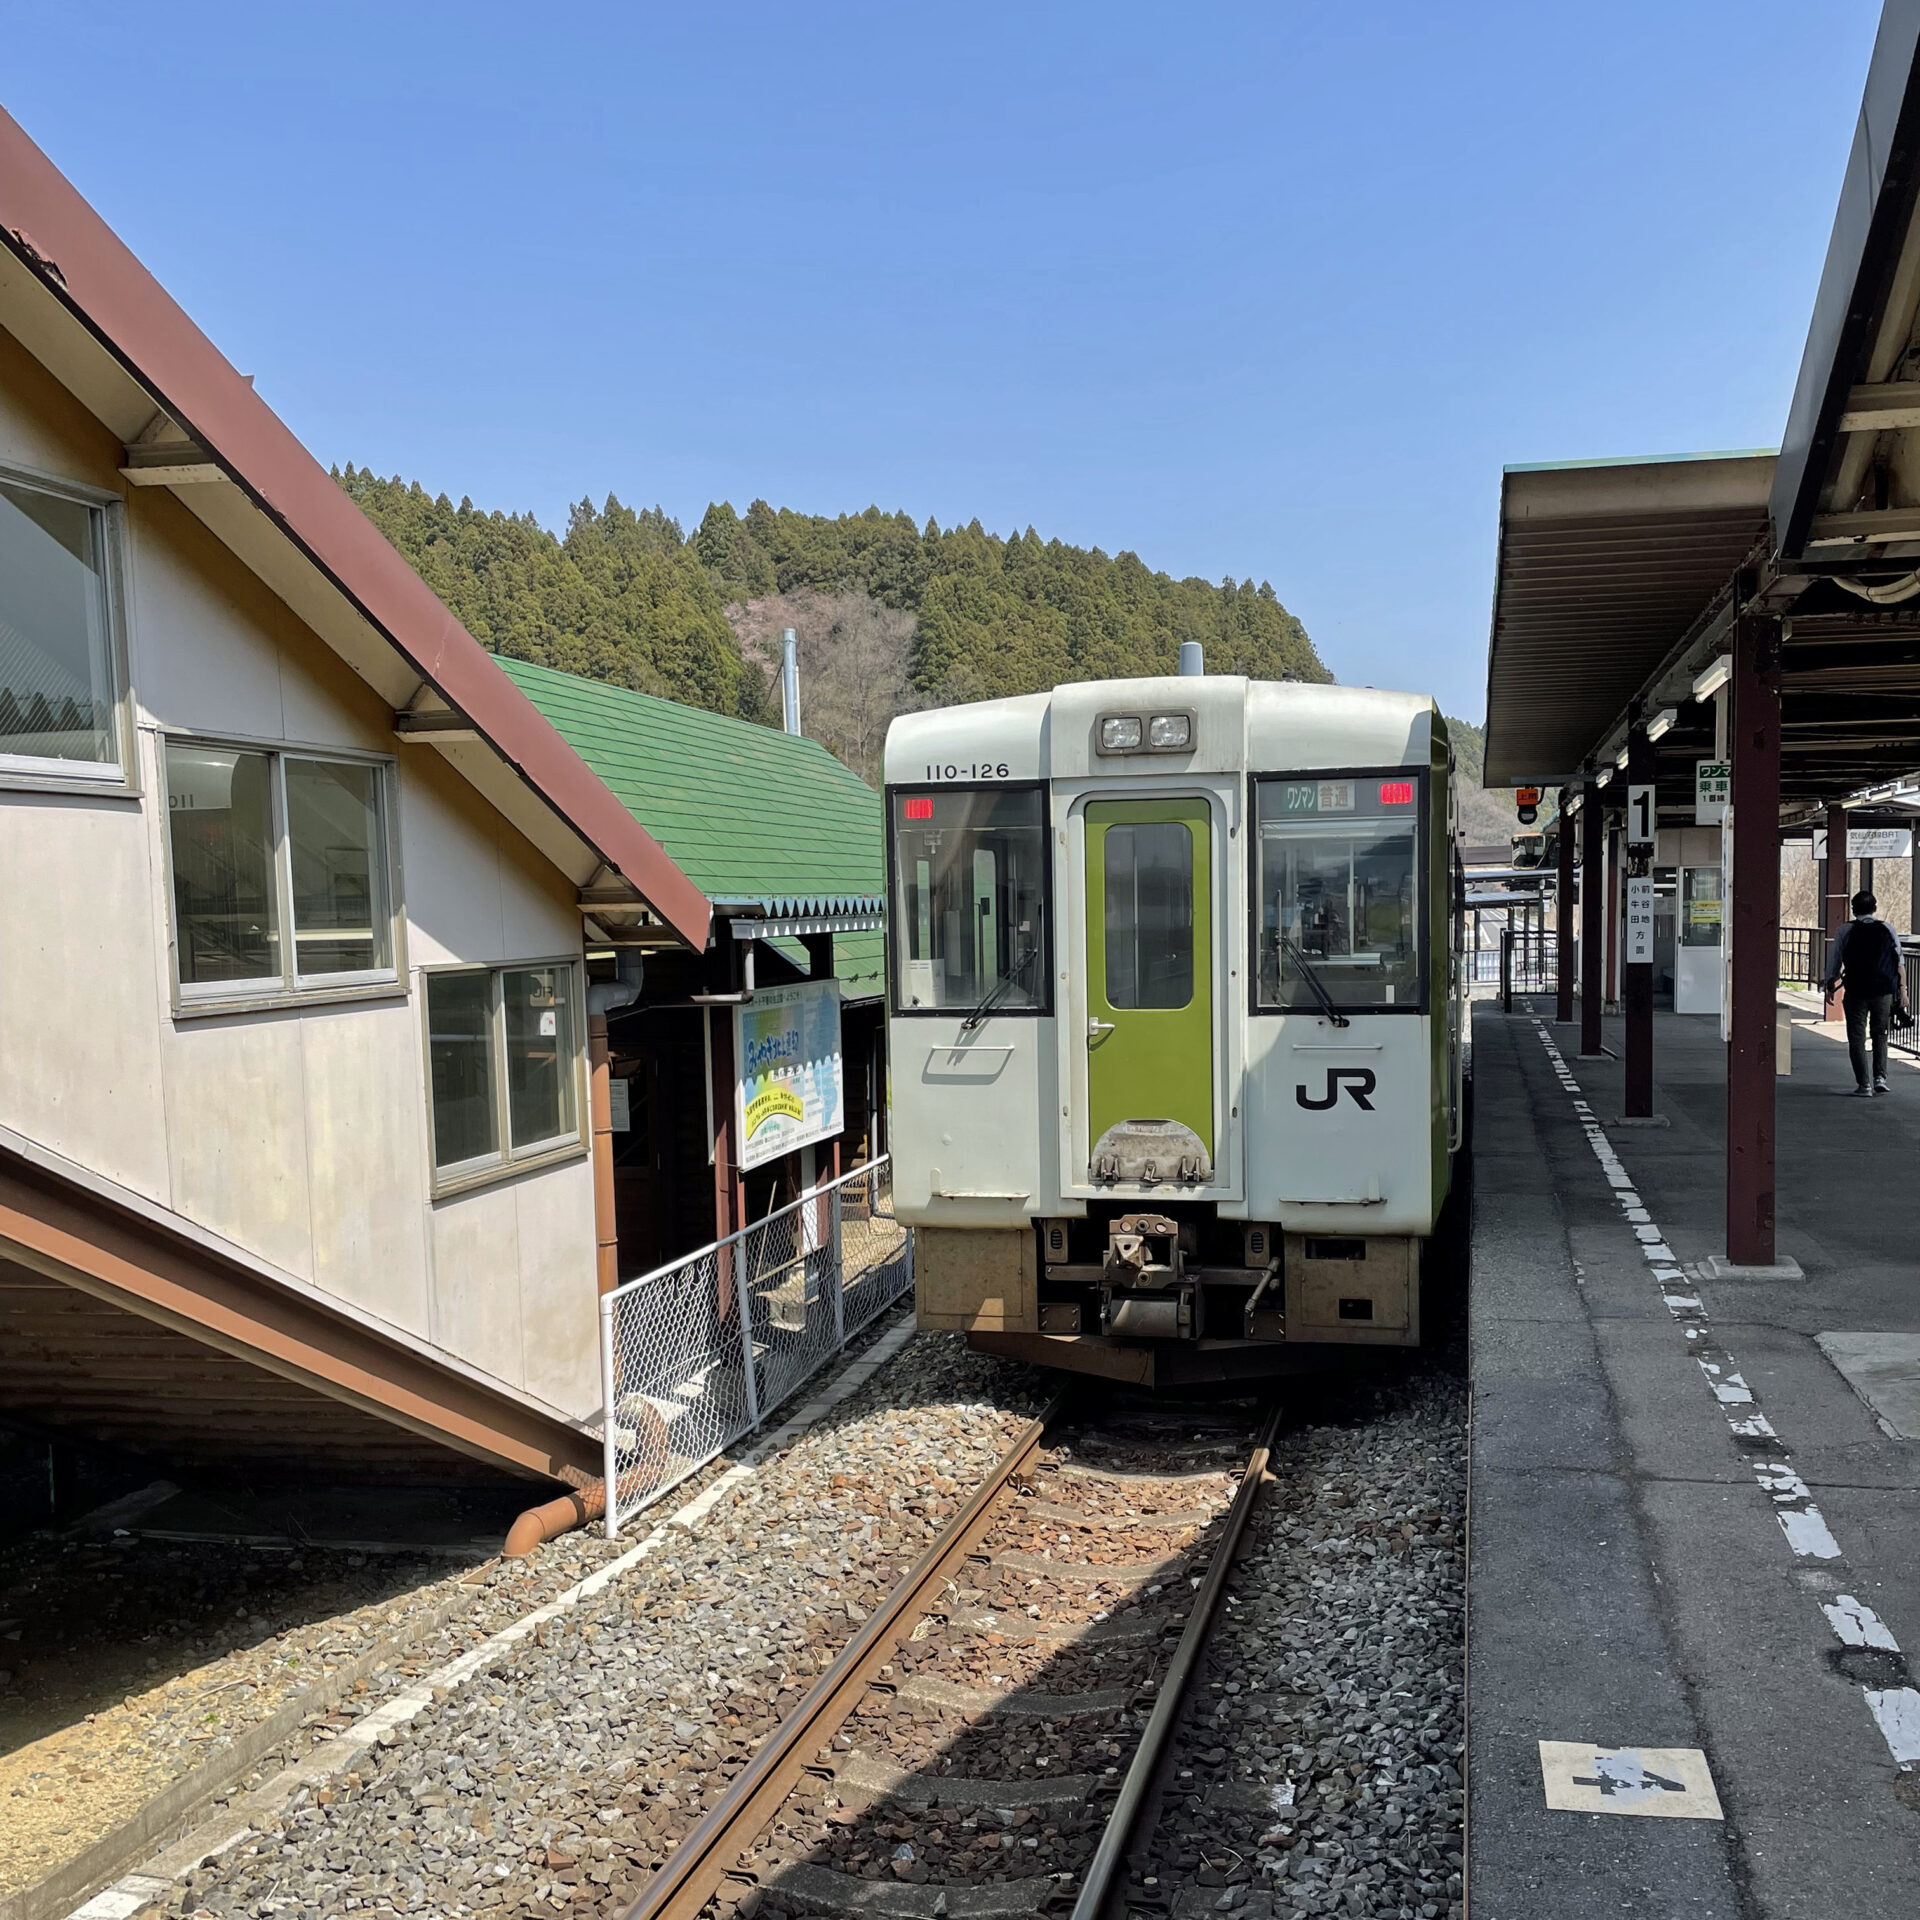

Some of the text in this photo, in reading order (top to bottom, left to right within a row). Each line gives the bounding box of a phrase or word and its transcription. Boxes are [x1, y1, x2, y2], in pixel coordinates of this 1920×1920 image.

[927, 763, 1009, 780] 110-126
[1287, 786, 1315, 809] ワンマン
[1320, 785, 1349, 808] 普通
[1633, 791, 1649, 837] 1
[1630, 884, 1640, 924] 小牛田
[1641, 884, 1650, 924] 前谷地
[1636, 931, 1645, 955] 方面
[1296, 1068, 1376, 1110] JR
